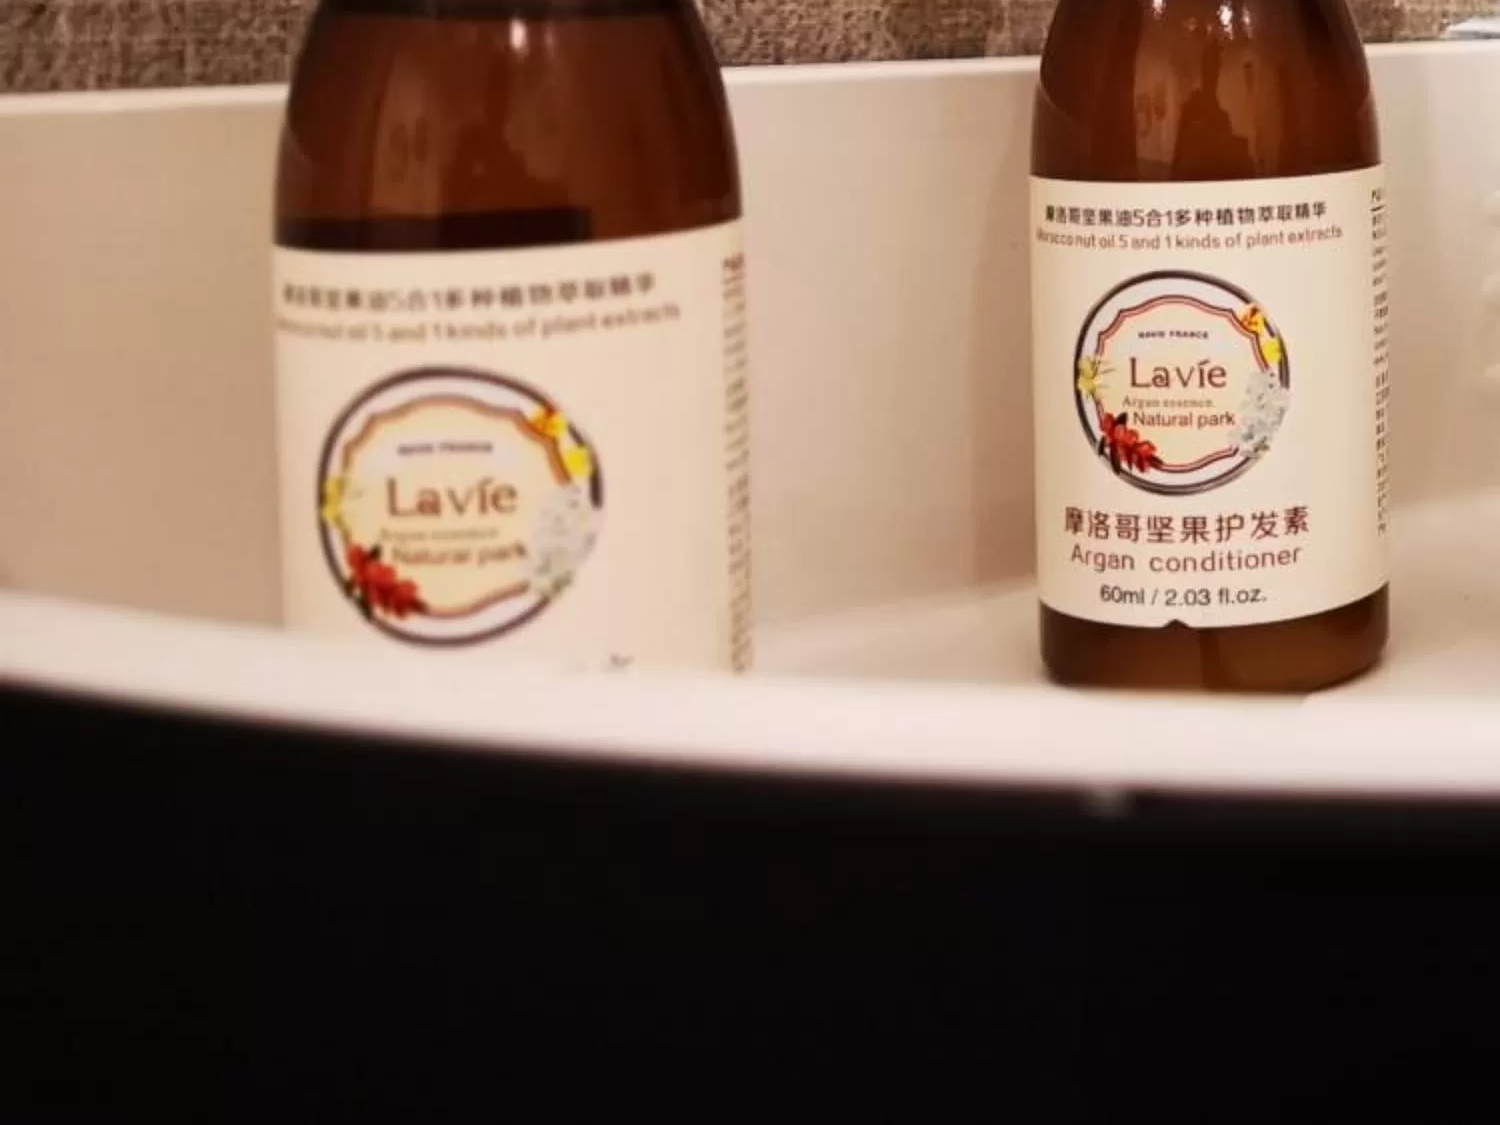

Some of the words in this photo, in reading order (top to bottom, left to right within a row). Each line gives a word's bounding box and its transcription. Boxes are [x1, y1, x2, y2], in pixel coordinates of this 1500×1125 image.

[1075, 233, 1096, 249] nut
[1099, 233, 1115, 250] oil
[1119, 234, 1129, 248] 5
[1132, 233, 1160, 251] and
[1176, 232, 1220, 250] kinds
[1225, 232, 1241, 249] of
[1246, 230, 1284, 249] plant
[1288, 225, 1342, 245] extracts
[1132, 410, 1193, 428] Natural
[1196, 410, 1237, 430] park
[1064, 505, 1310, 545] 摩洛哥坚果护发素
[1071, 544, 1136, 574] Argan
[1148, 544, 1303, 574] conditioner
[1099, 584, 1145, 605] 60ml
[1164, 587, 1211, 607] 2.03
[1217, 586, 1268, 606] fl.oz.
